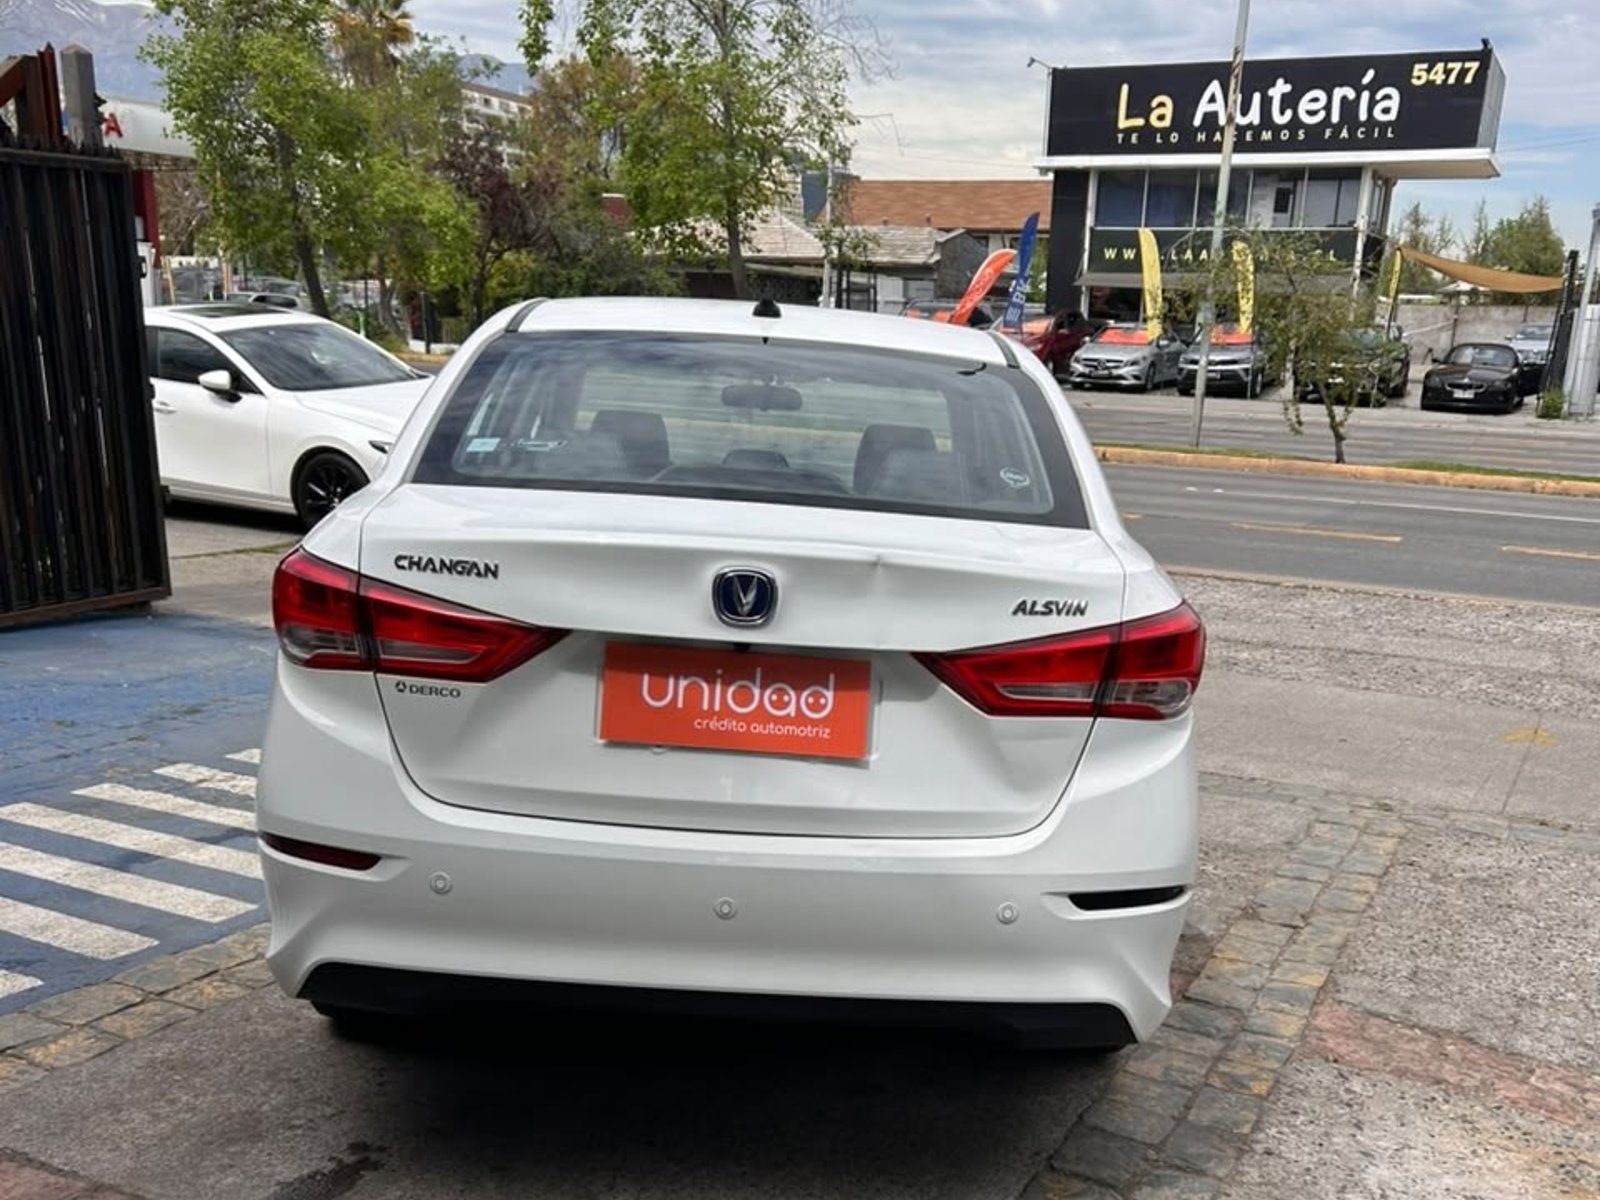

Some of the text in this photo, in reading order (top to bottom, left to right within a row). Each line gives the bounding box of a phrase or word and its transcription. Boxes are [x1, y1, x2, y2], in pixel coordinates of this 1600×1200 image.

[1410, 61, 1480, 86] 5477
[1117, 67, 1400, 130] La Autería
[1117, 132, 1139, 144] TE
[1156, 131, 1179, 143] LO
[1324, 124, 1394, 140] FÁCIL
[394, 554, 499, 580] CHANGAN
[1011, 599, 1089, 617] ALSVIN
[409, 684, 461, 699] DERCO
[642, 667, 835, 719] unidad
[694, 716, 831, 739] crédito automotriz
